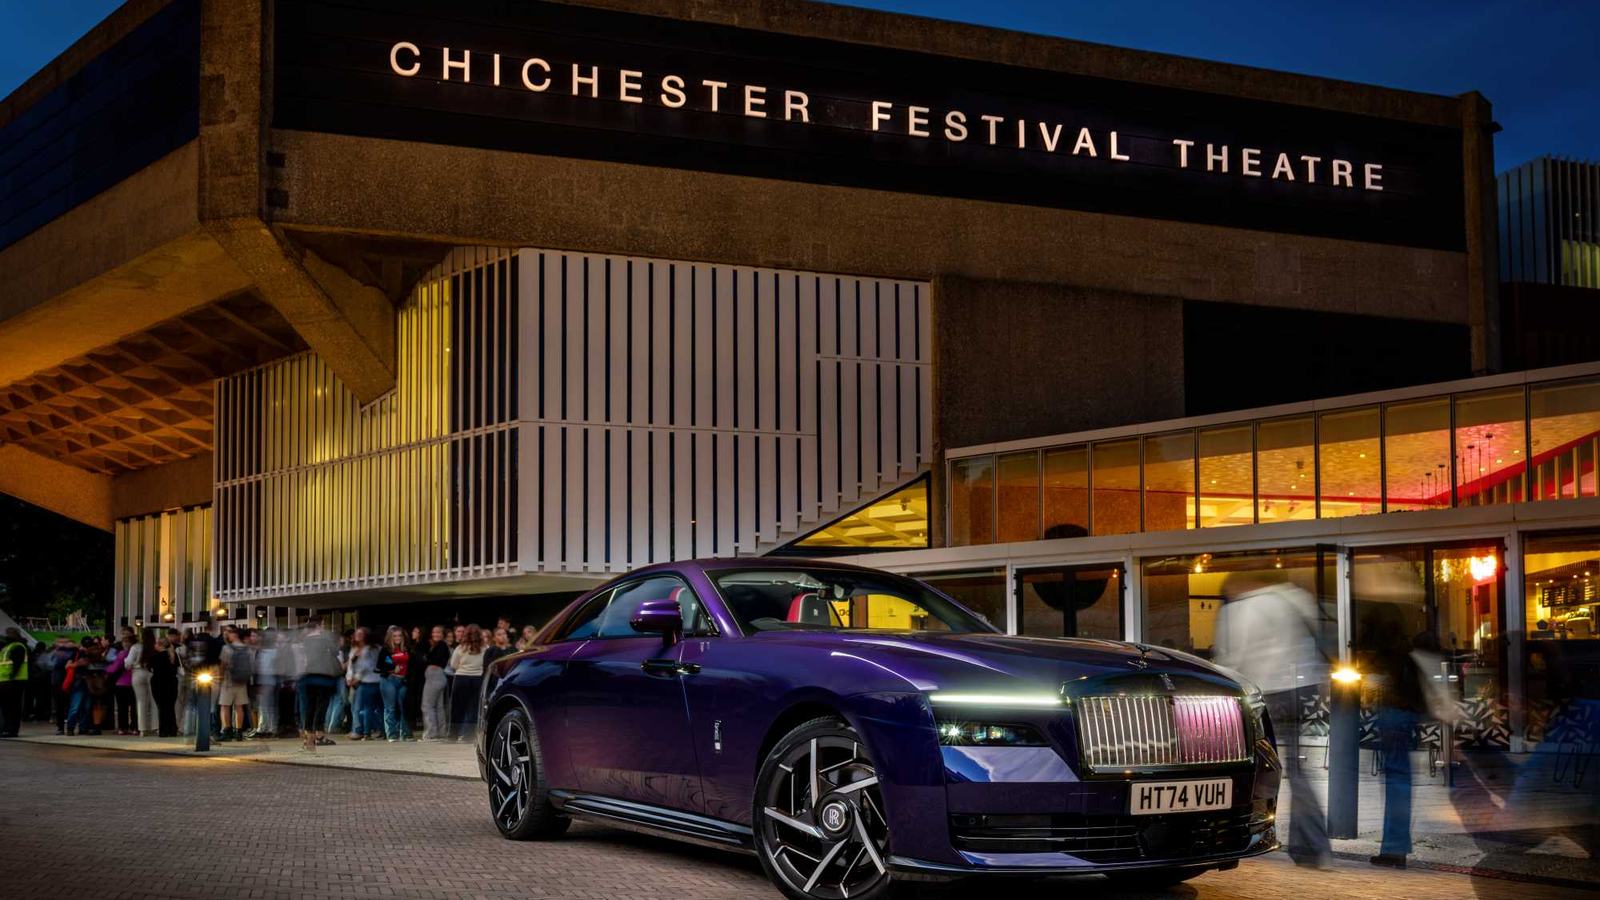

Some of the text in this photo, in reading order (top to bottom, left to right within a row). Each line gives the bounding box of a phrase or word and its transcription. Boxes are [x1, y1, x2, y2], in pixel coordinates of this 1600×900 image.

[390, 42, 1383, 190] CHICHESTER FESTIVAL THEATRE
[1139, 783, 1226, 810] HT74 VUH
